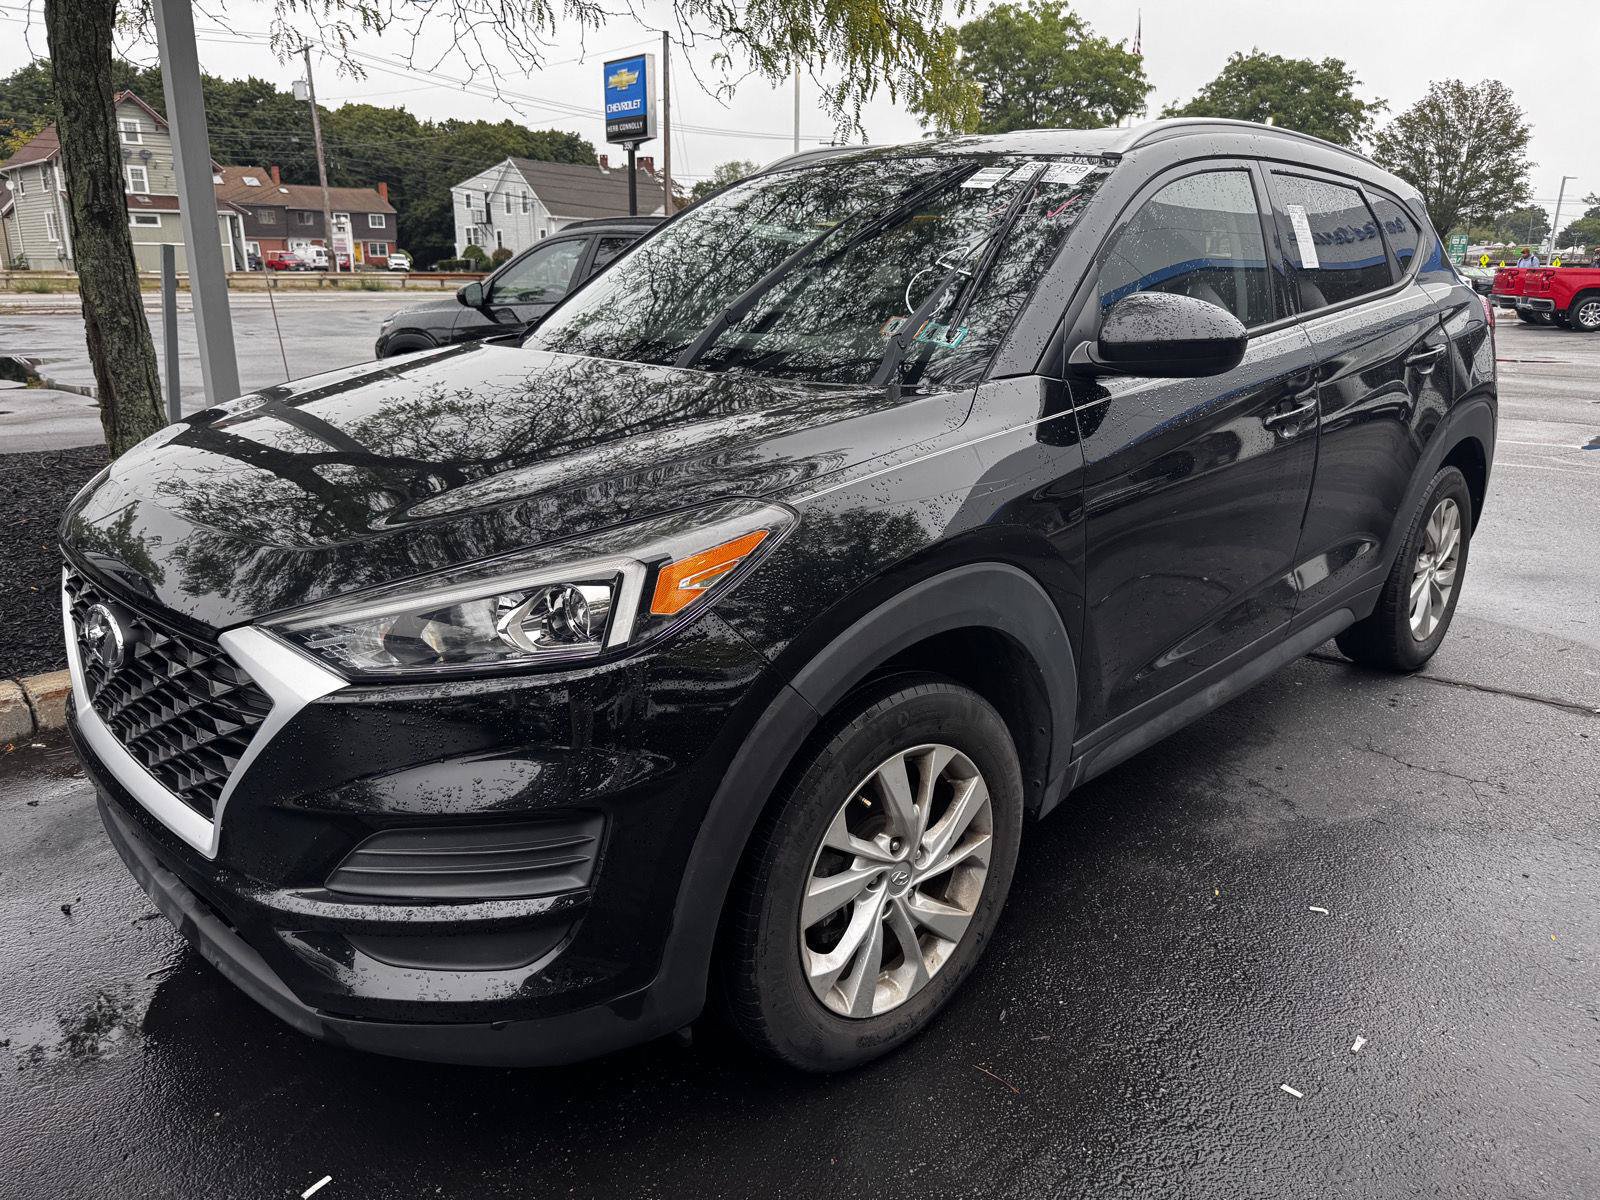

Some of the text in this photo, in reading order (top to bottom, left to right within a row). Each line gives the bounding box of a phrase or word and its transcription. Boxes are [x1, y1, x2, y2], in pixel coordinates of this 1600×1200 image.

[607, 99, 641, 113] CHEVROLET
[607, 121, 643, 133] HERB CONNOLLY
[1023, 163, 1088, 174] 692199
